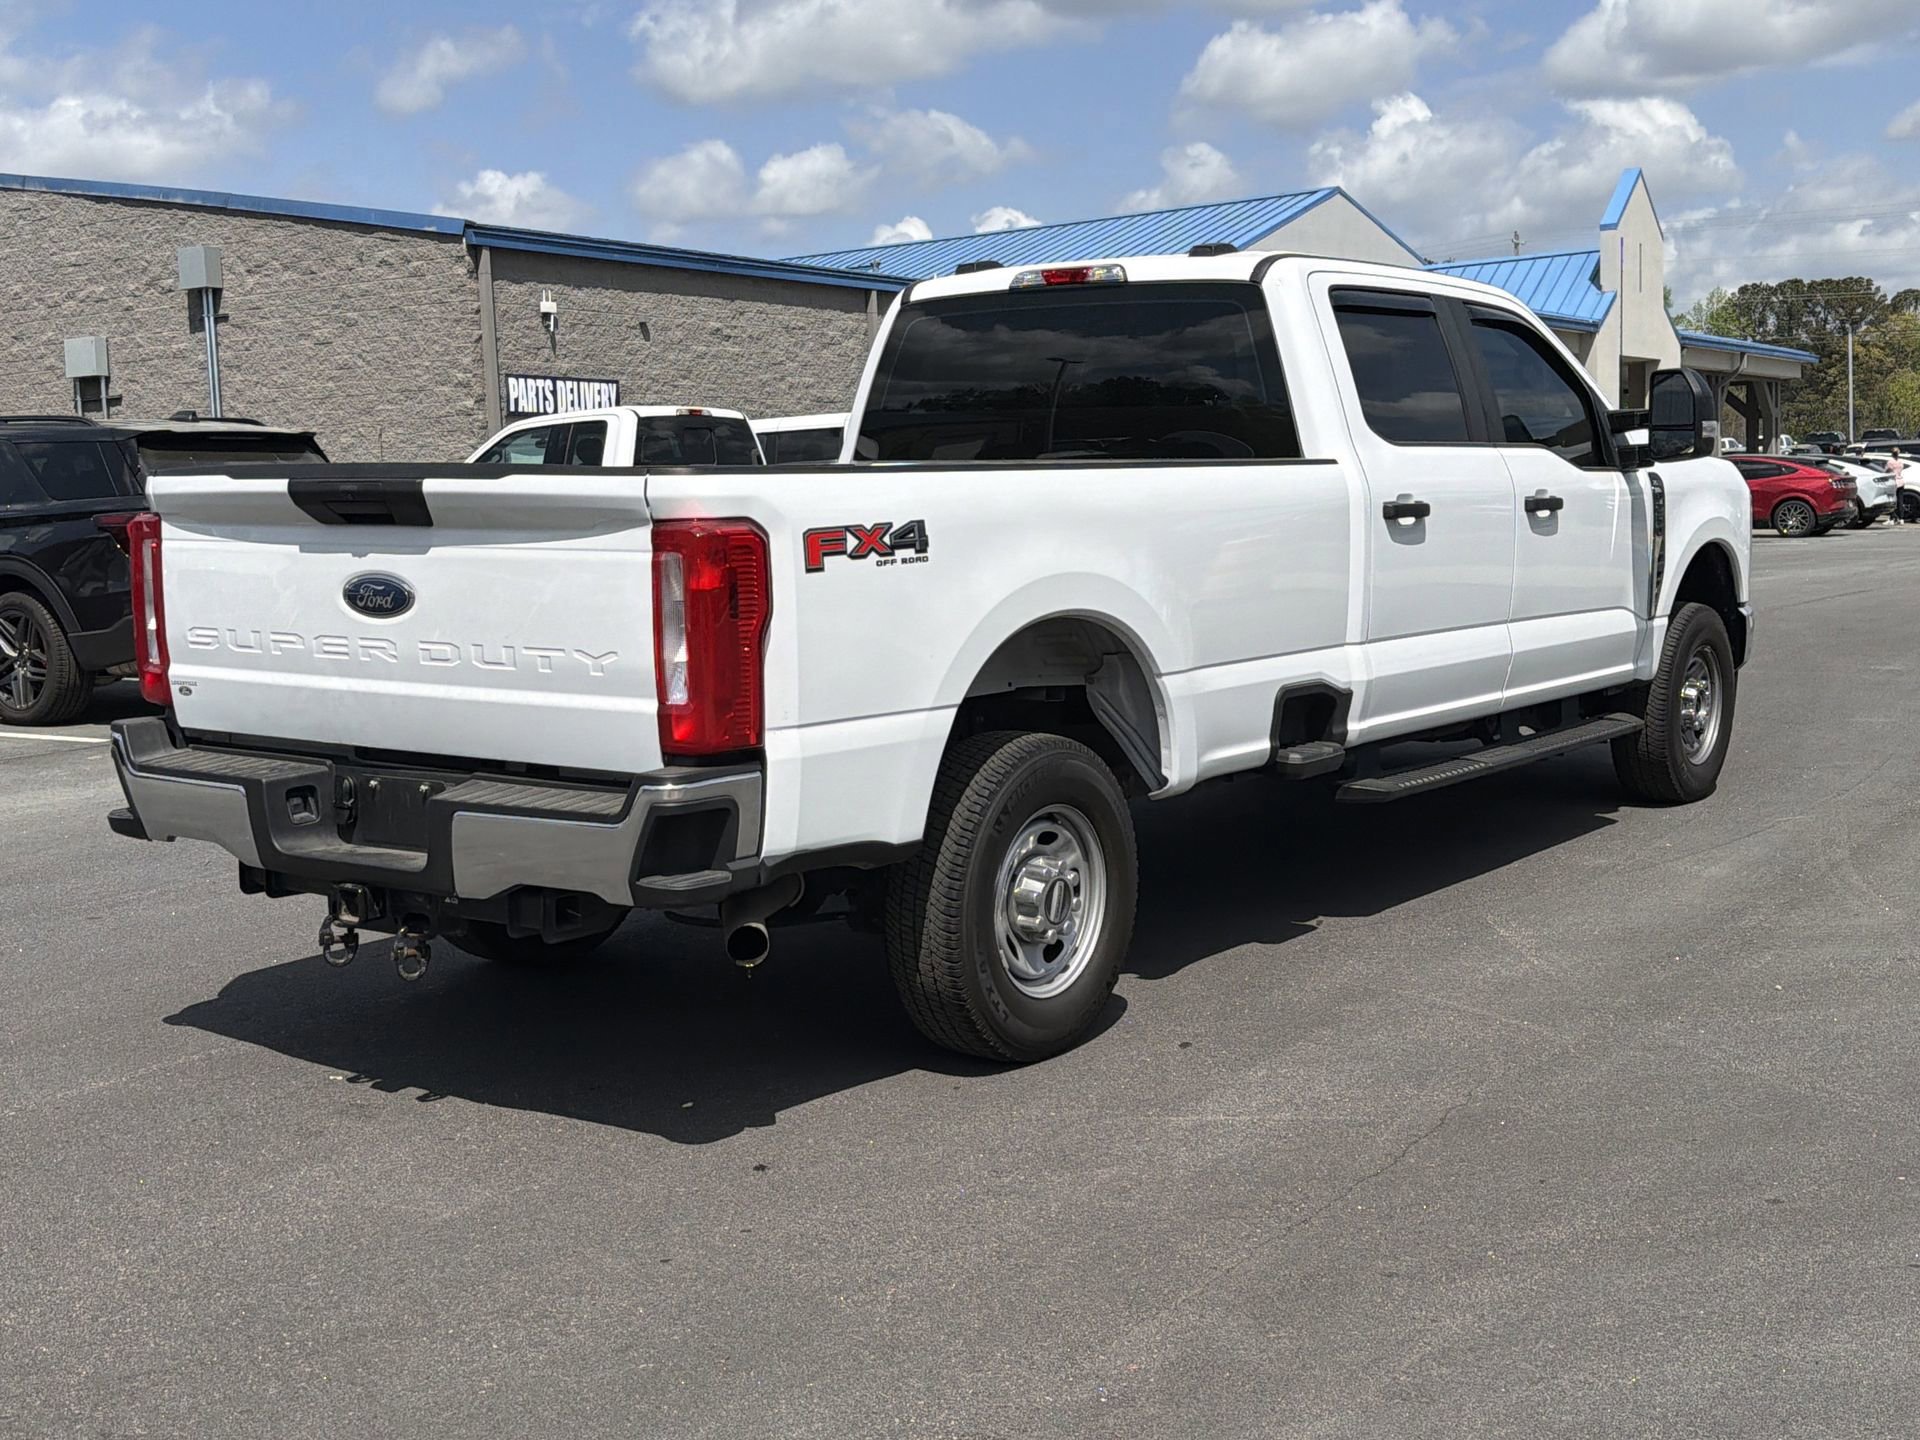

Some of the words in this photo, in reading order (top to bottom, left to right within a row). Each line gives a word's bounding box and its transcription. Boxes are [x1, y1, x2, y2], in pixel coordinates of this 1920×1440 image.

[508, 377, 555, 414] PARTS
[556, 380, 617, 414] DELIVERY
[803, 519, 929, 574] FX4
[876, 559, 898, 567] OFF
[901, 555, 929, 565] ROAD
[357, 583, 396, 609] Ford
[187, 626, 398, 663] SUPER
[418, 640, 619, 677] DUTY
